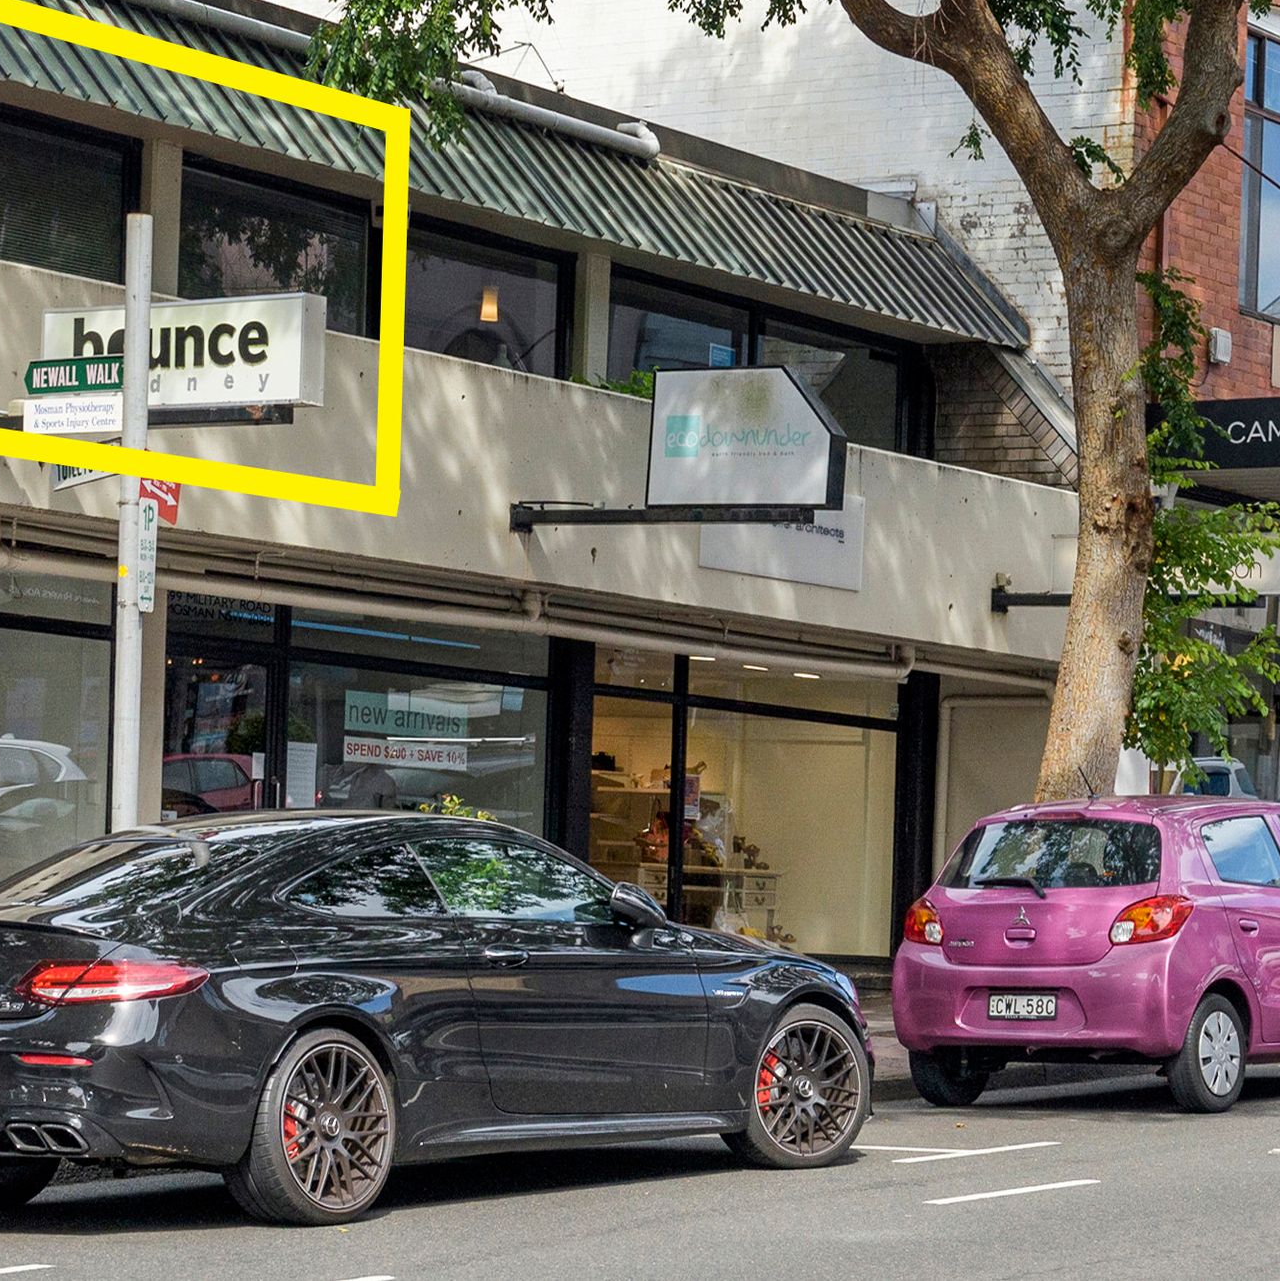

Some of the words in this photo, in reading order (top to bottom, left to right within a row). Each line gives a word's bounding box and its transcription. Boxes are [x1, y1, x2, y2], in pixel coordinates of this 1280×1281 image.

[73, 318, 270, 369] bunce
[32, 365, 79, 389] NEWALL
[86, 363, 120, 385] WALK
[34, 404, 63, 415] Mosman
[65, 402, 115, 416] Physiotherapy
[41, 419, 65, 430] Sports
[66, 418, 90, 429] Injury
[91, 416, 116, 426] Centre
[186, 592, 236, 609] MILITARY
[240, 600, 271, 613] ROAD
[349, 704, 387, 724] new
[394, 707, 461, 733] arrivals
[346, 743, 381, 757] SPEND
[417, 749, 443, 762] SAVE
[447, 752, 465, 764] 10%
